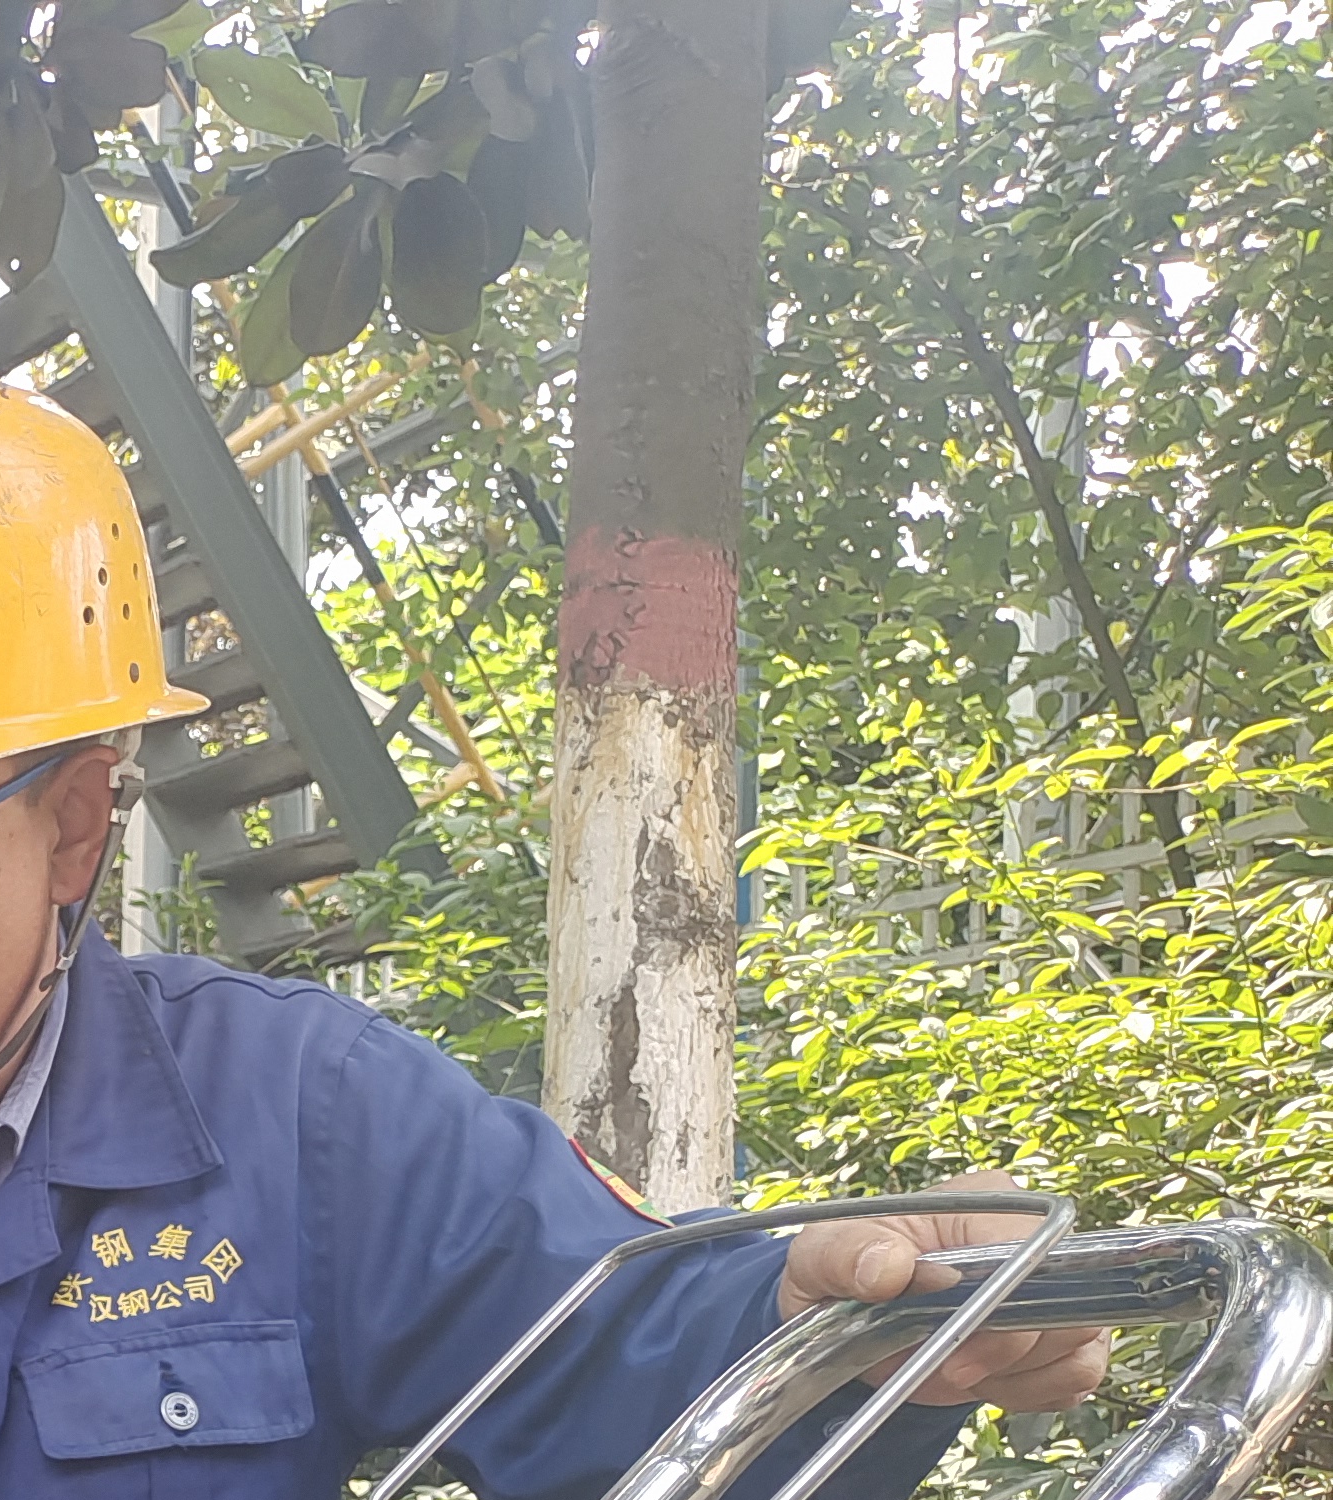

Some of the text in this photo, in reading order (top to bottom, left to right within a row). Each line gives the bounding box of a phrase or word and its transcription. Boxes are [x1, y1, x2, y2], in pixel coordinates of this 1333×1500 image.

[51, 1223, 244, 1308] 陕钢集团
[88, 1273, 216, 1323] 汉钢公司
